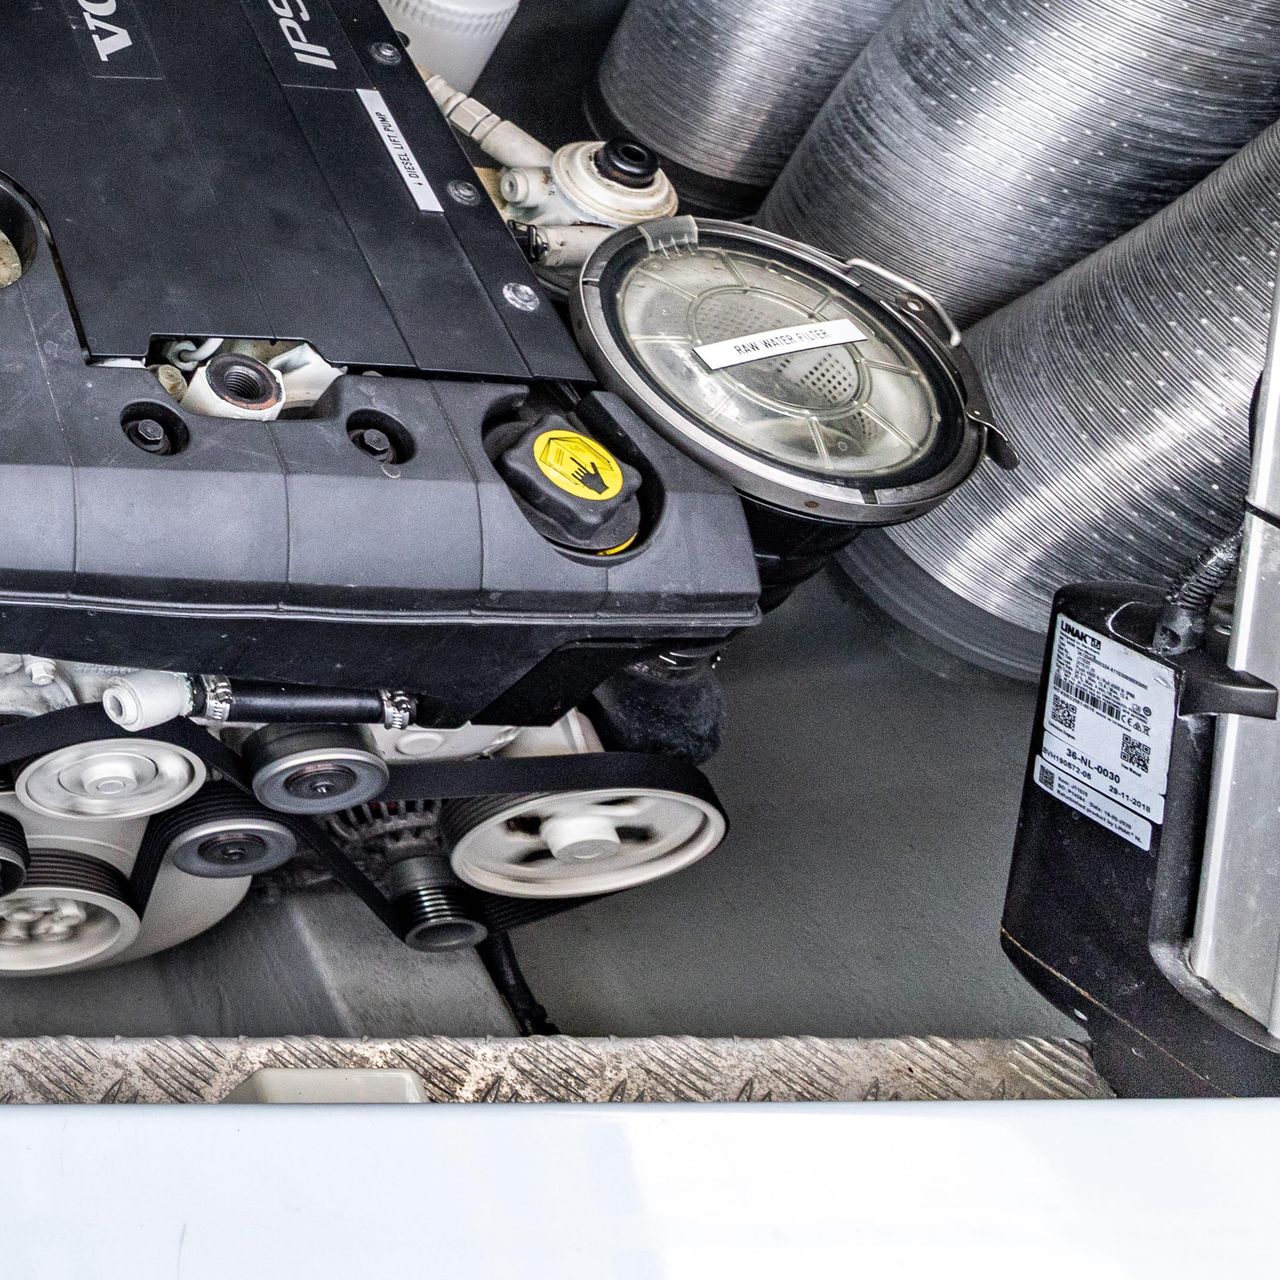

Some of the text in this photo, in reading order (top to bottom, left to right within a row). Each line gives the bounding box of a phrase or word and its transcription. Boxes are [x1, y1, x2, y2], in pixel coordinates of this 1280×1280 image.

[375, 111, 419, 179] DIESEL LIFT PUMP
[734, 328, 831, 355] RAW WATER FILTER
[1065, 747, 1120, 784] 36-NL-0030
